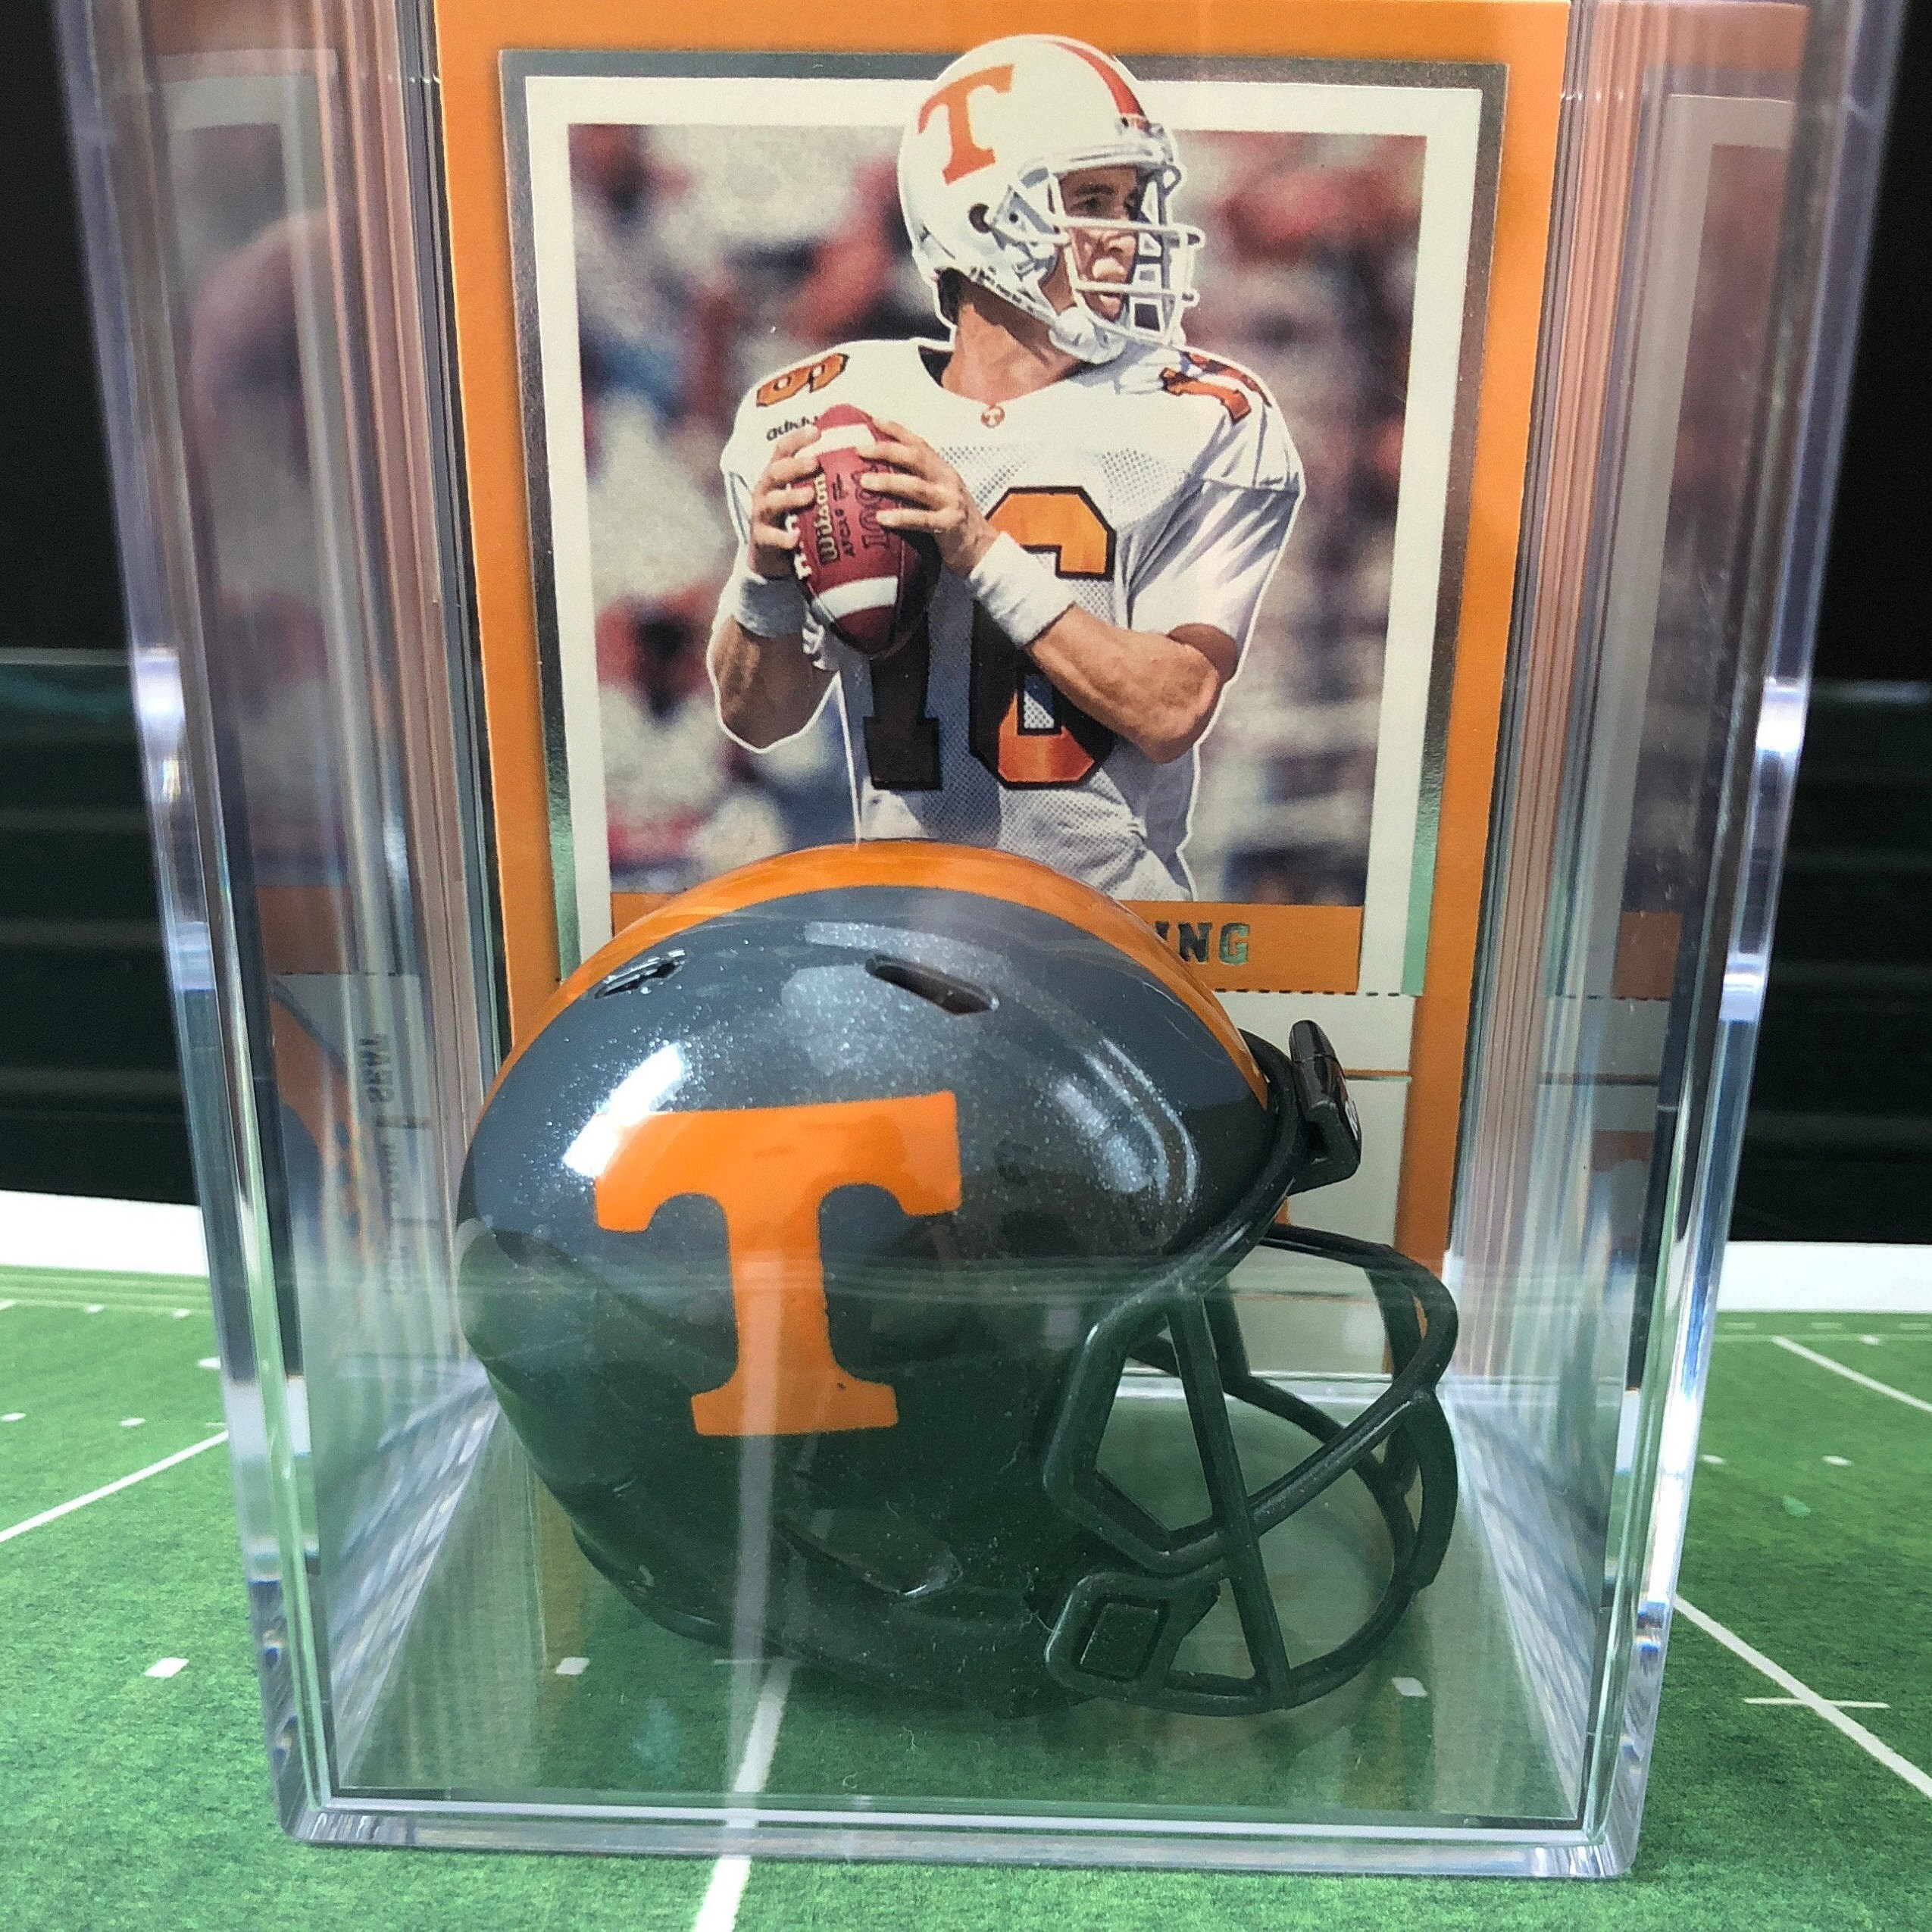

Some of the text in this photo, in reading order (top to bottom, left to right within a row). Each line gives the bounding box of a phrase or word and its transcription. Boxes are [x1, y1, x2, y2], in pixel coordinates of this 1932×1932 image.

[918, 64, 1014, 186] T
[814, 474, 839, 562] Wilson
[851, 464, 891, 549] 100
[595, 1089, 962, 1436] T
